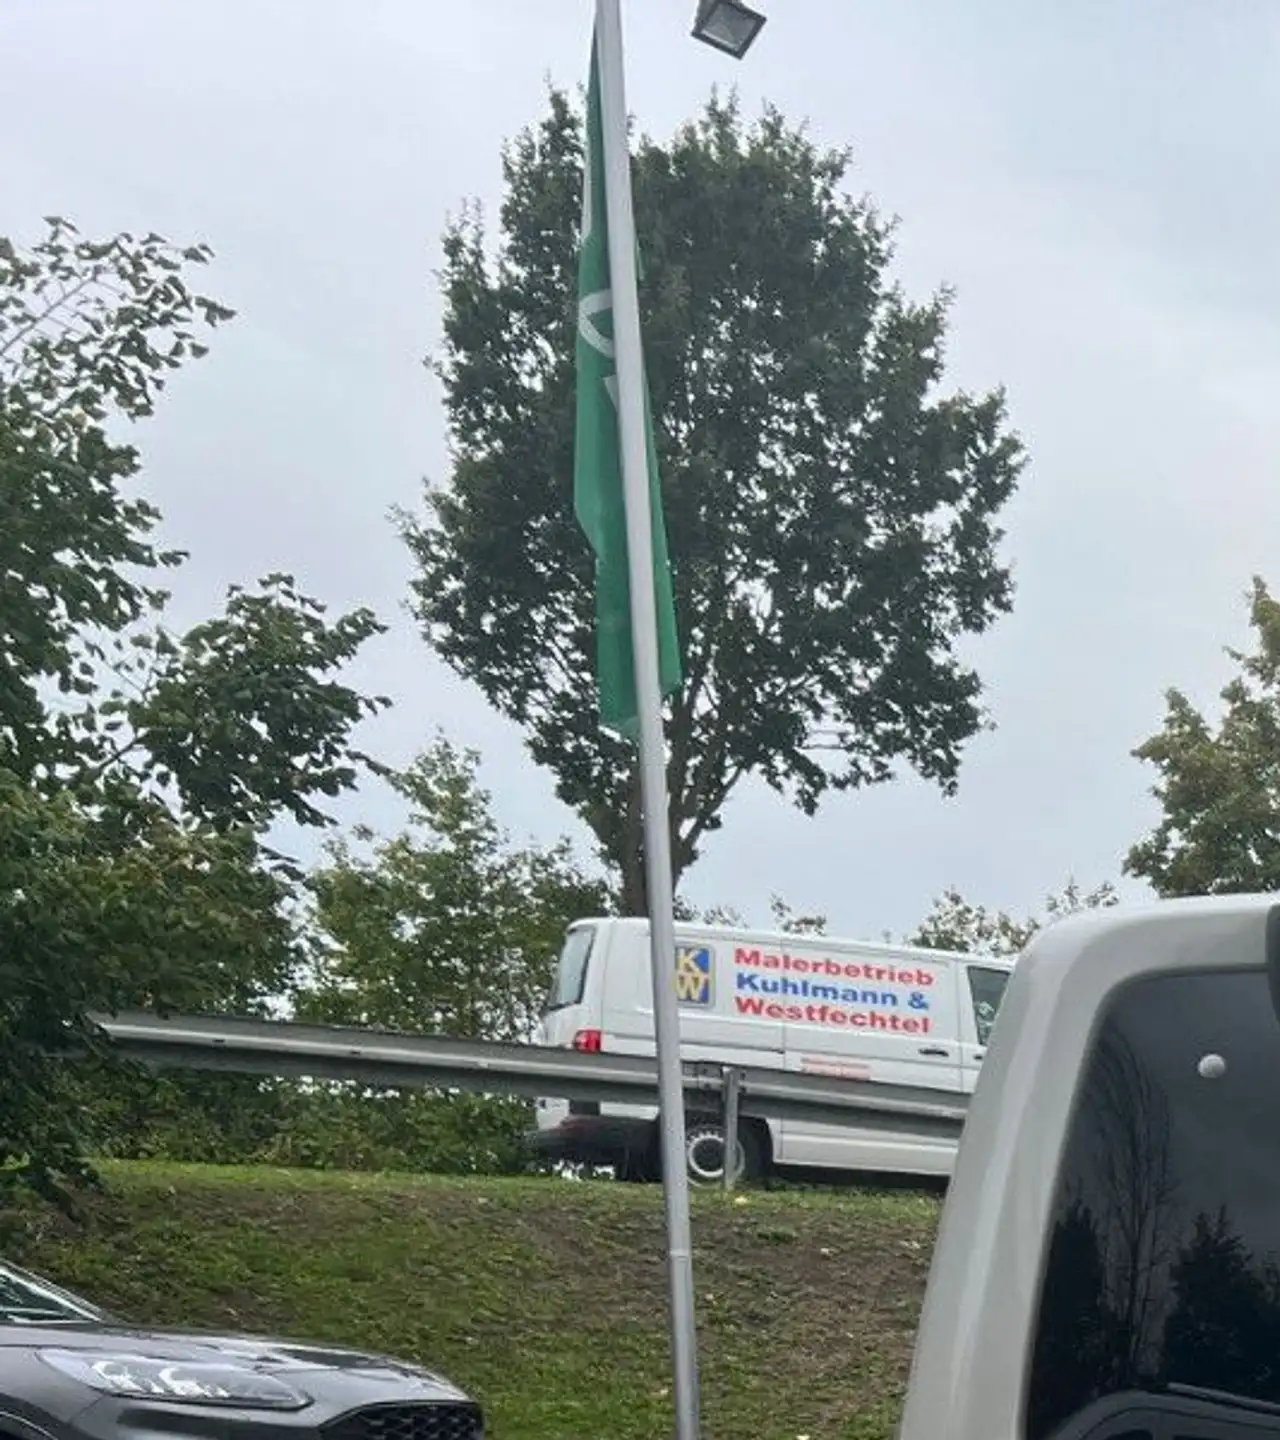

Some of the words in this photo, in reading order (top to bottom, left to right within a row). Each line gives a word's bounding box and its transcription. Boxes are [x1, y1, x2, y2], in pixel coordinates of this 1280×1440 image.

[734, 947, 935, 987] Malerbetrieb
[736, 971, 899, 1007] Kuhlmann
[906, 991, 930, 1011] &
[734, 995, 931, 1034] Westfechtel
